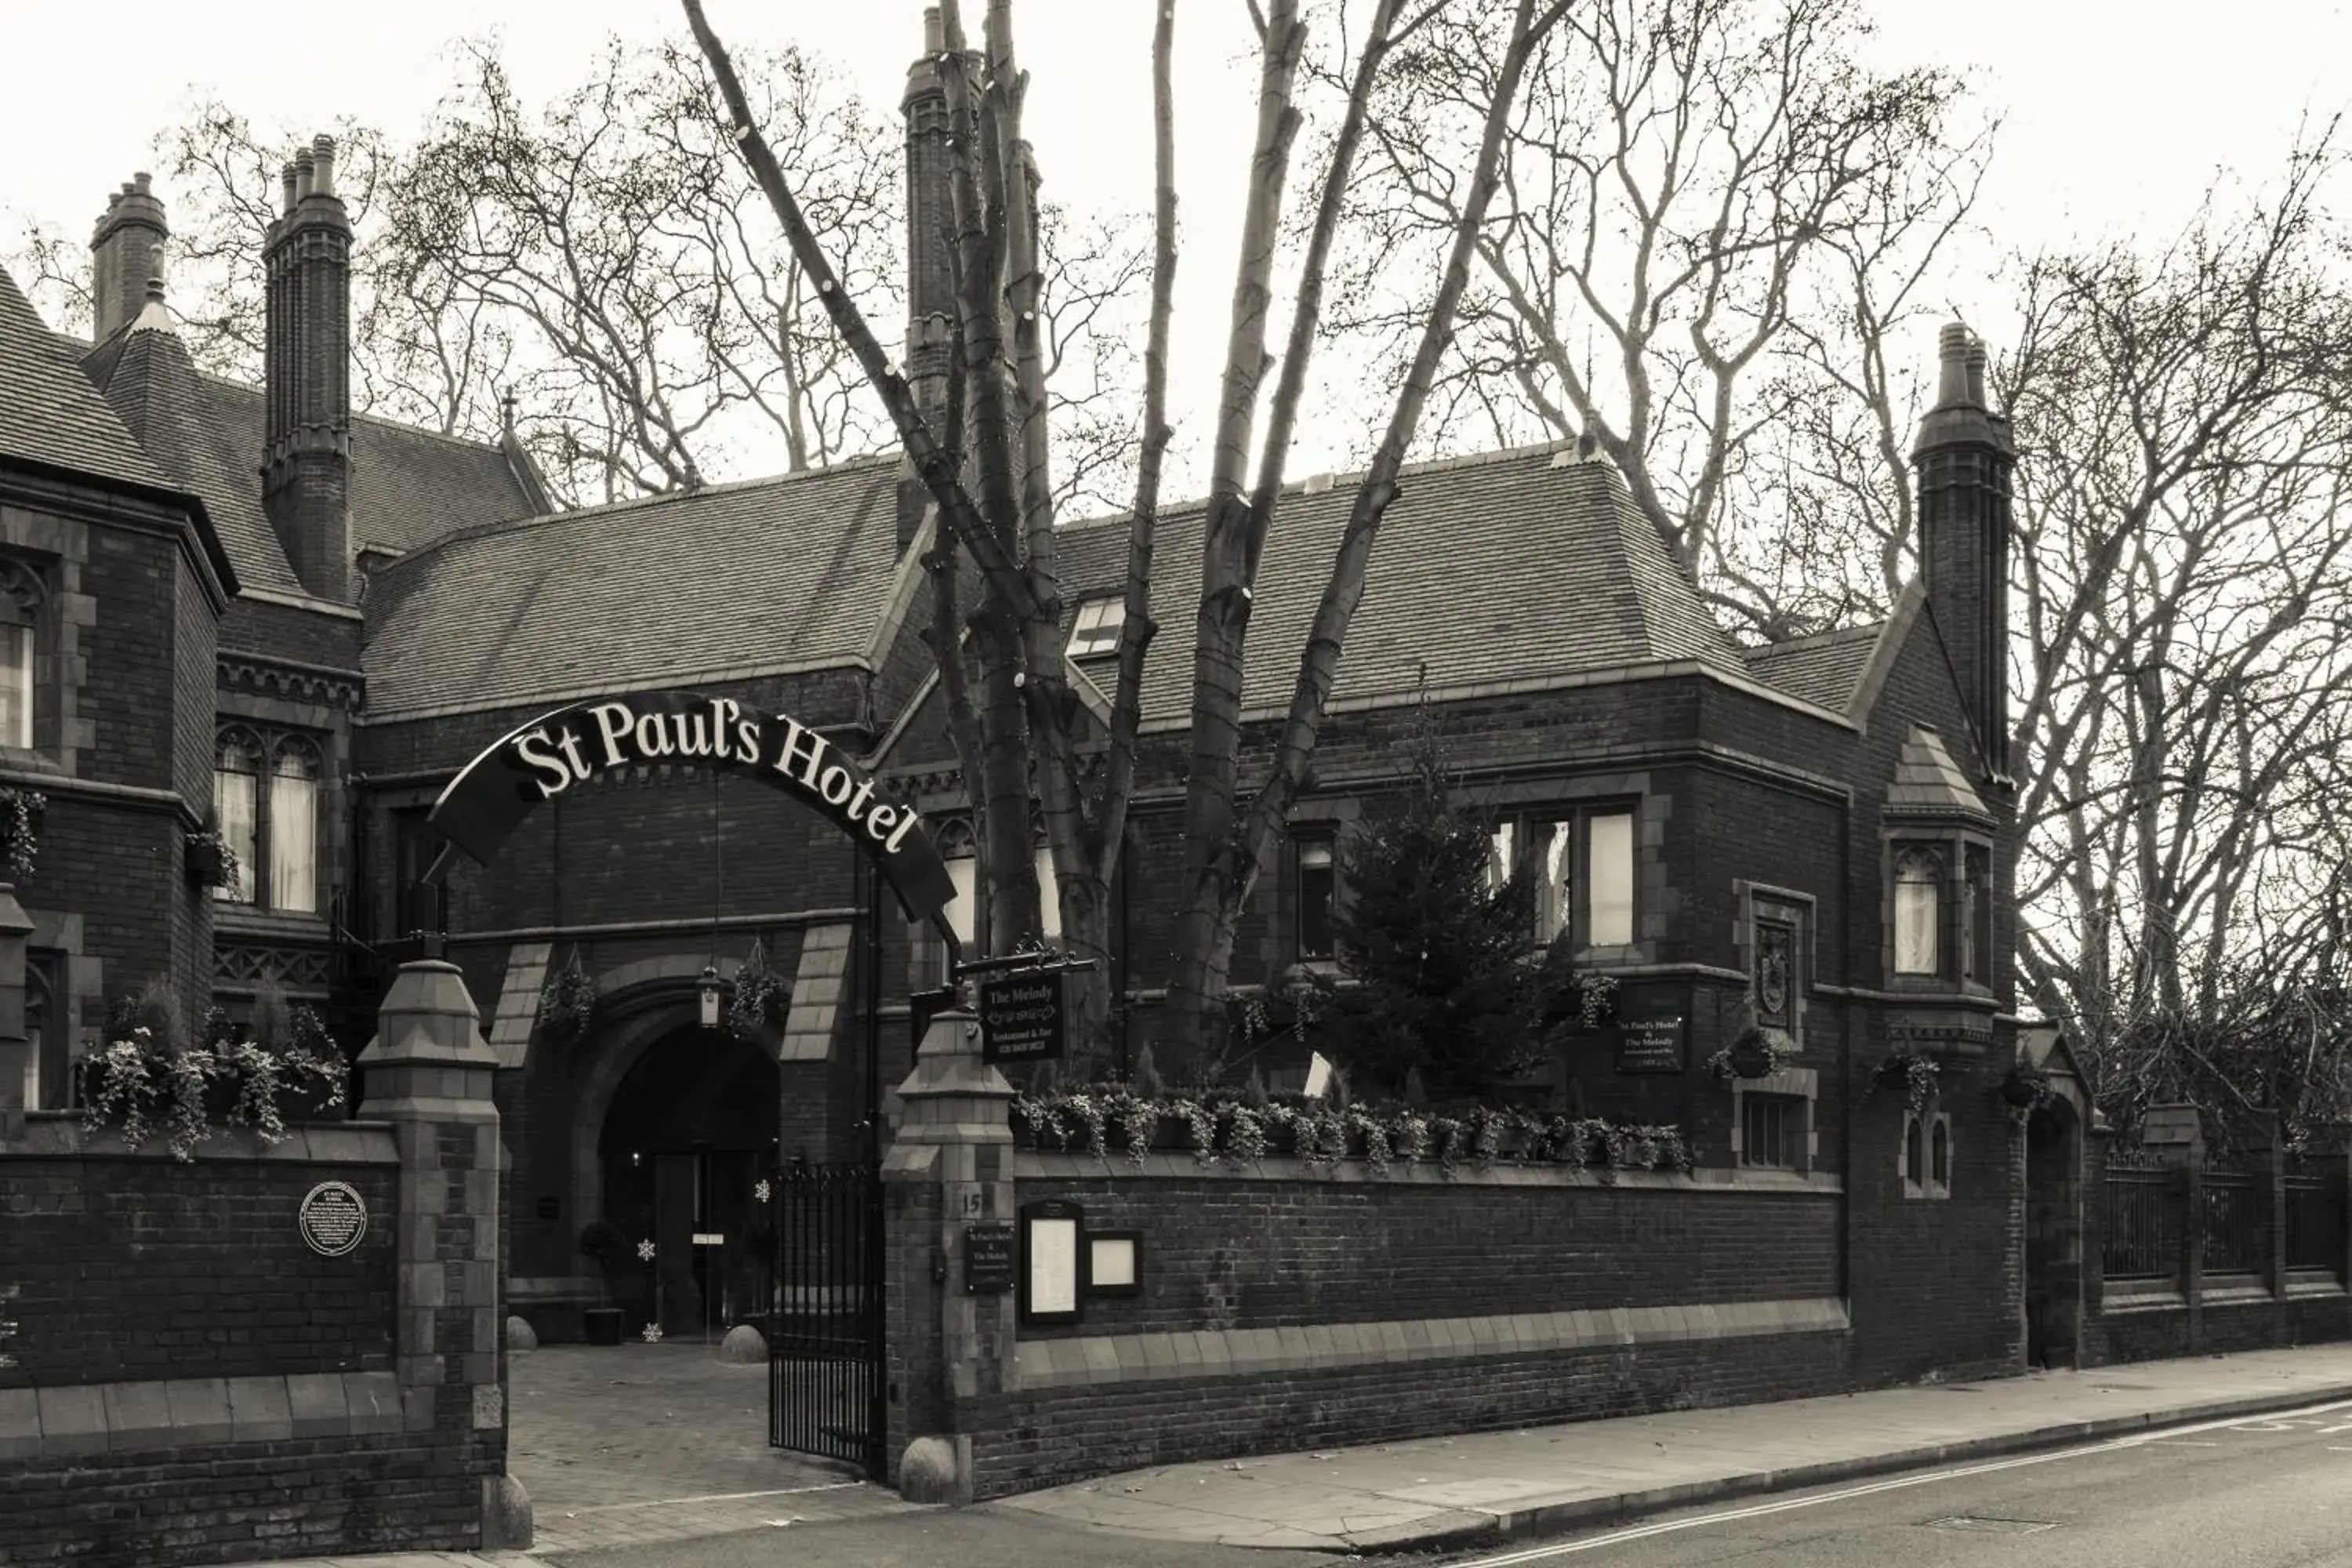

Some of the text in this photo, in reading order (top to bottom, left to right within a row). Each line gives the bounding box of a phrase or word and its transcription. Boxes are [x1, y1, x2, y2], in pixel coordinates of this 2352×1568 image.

[511, 698, 918, 854] St Paul's Hotel
[1012, 985, 1052, 1003] Melody
